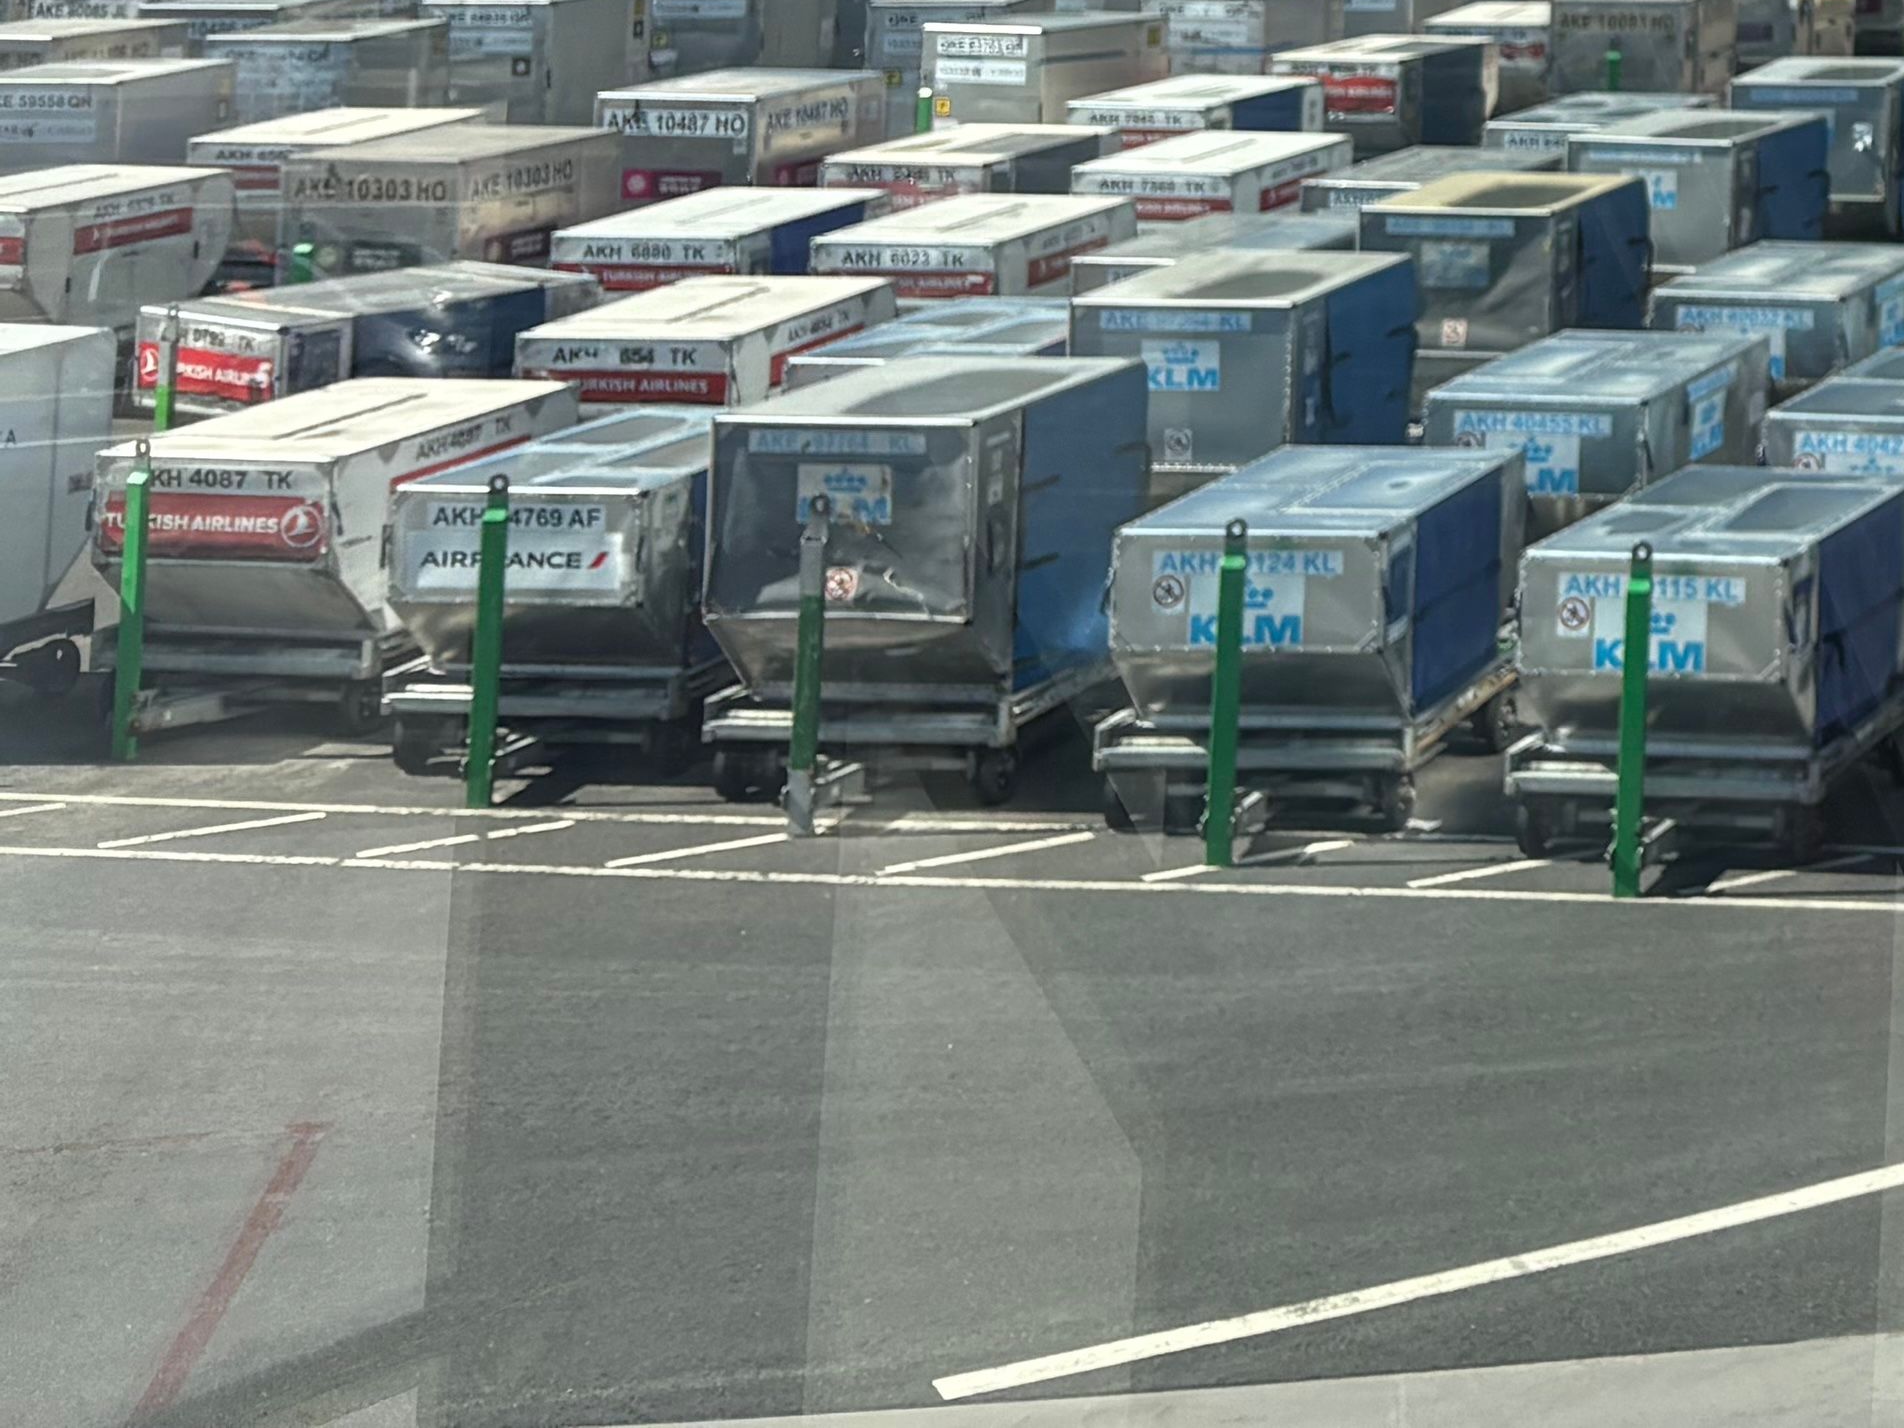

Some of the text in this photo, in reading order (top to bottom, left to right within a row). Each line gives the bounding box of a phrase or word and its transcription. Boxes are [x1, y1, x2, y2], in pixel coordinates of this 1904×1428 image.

[656, 111, 709, 134] 10487
[348, 178, 411, 201] 10303
[583, 245, 622, 260] AKH
[683, 246, 705, 260] TK
[842, 250, 881, 266] AKH
[942, 251, 964, 267] TK
[671, 347, 697, 365] TK
[639, 379, 708, 394] AIRLINES
[1460, 413, 1506, 432] AKH
[151, 469, 294, 491] KH 4087 TK
[191, 515, 280, 534] AIRLINES
[568, 508, 602, 528] AF
[420, 550, 583, 570] AIRFANCE
[1159, 554, 1216, 574] AKH
[1304, 553, 1335, 572] KL
[1564, 574, 1621, 595] AKH
[1706, 579, 1738, 600] KL
[1190, 615, 1301, 645] KM
[1595, 639, 1705, 672] KM
